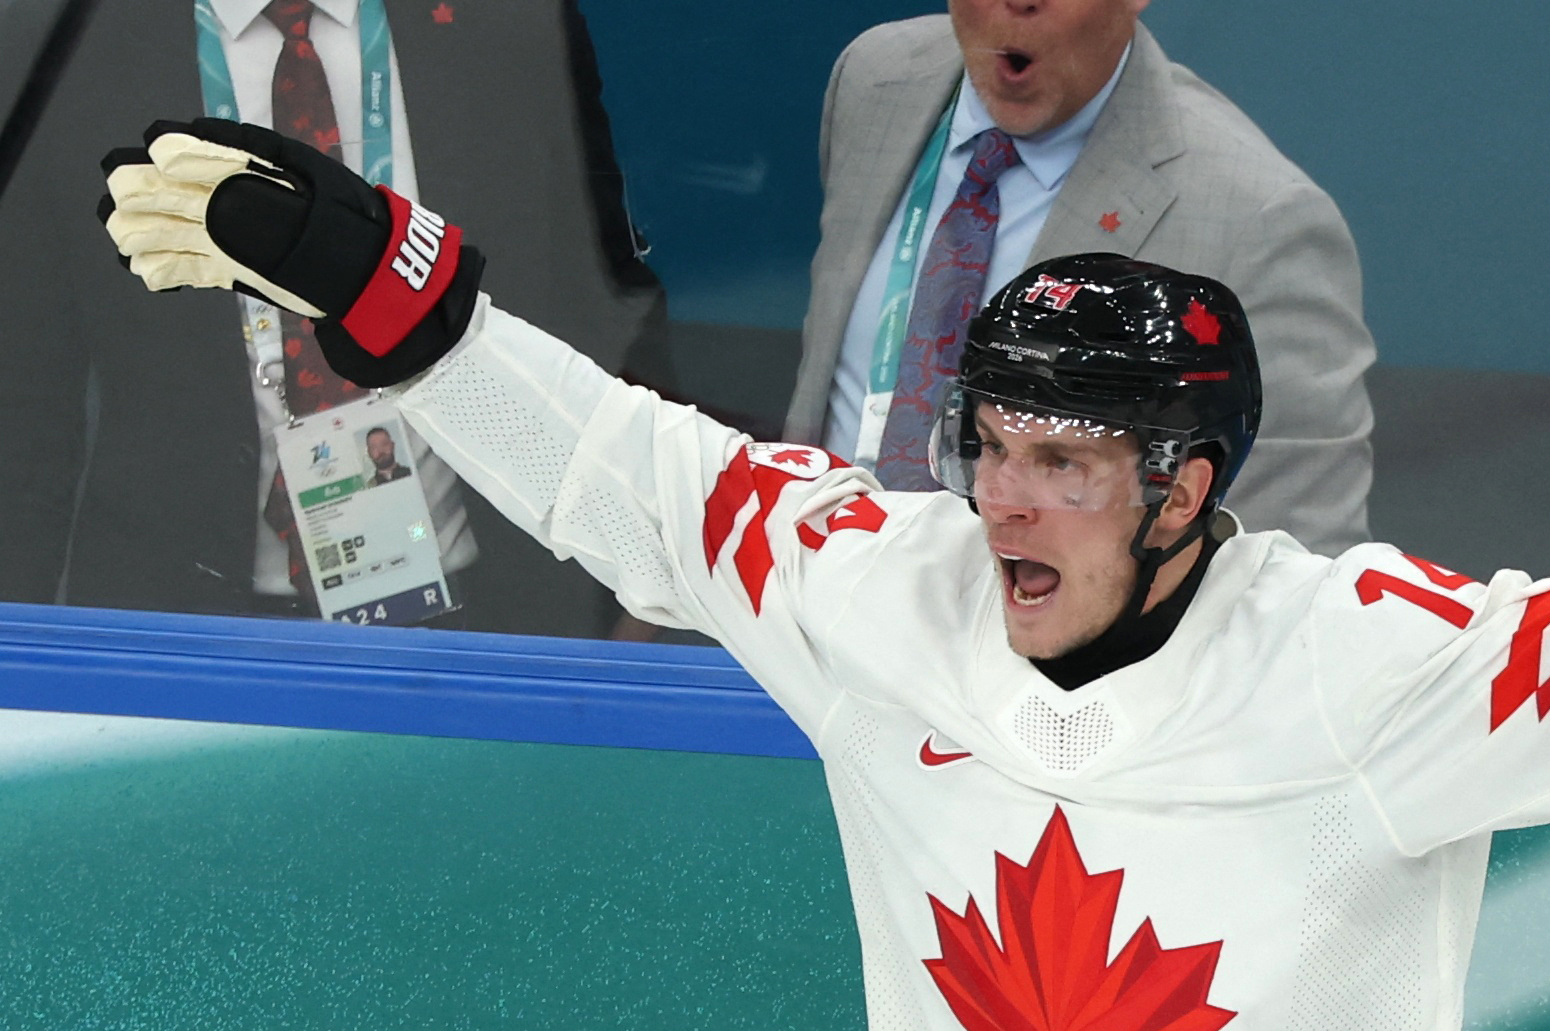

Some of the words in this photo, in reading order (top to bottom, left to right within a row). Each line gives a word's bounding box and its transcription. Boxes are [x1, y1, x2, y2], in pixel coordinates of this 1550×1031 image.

[1024, 273, 1085, 311] 14
[988, 341, 1017, 354] MILANO
[1017, 345, 1050, 362] CORTINA
[1007, 352, 1023, 362] 2026
[423, 588, 438, 606] R
